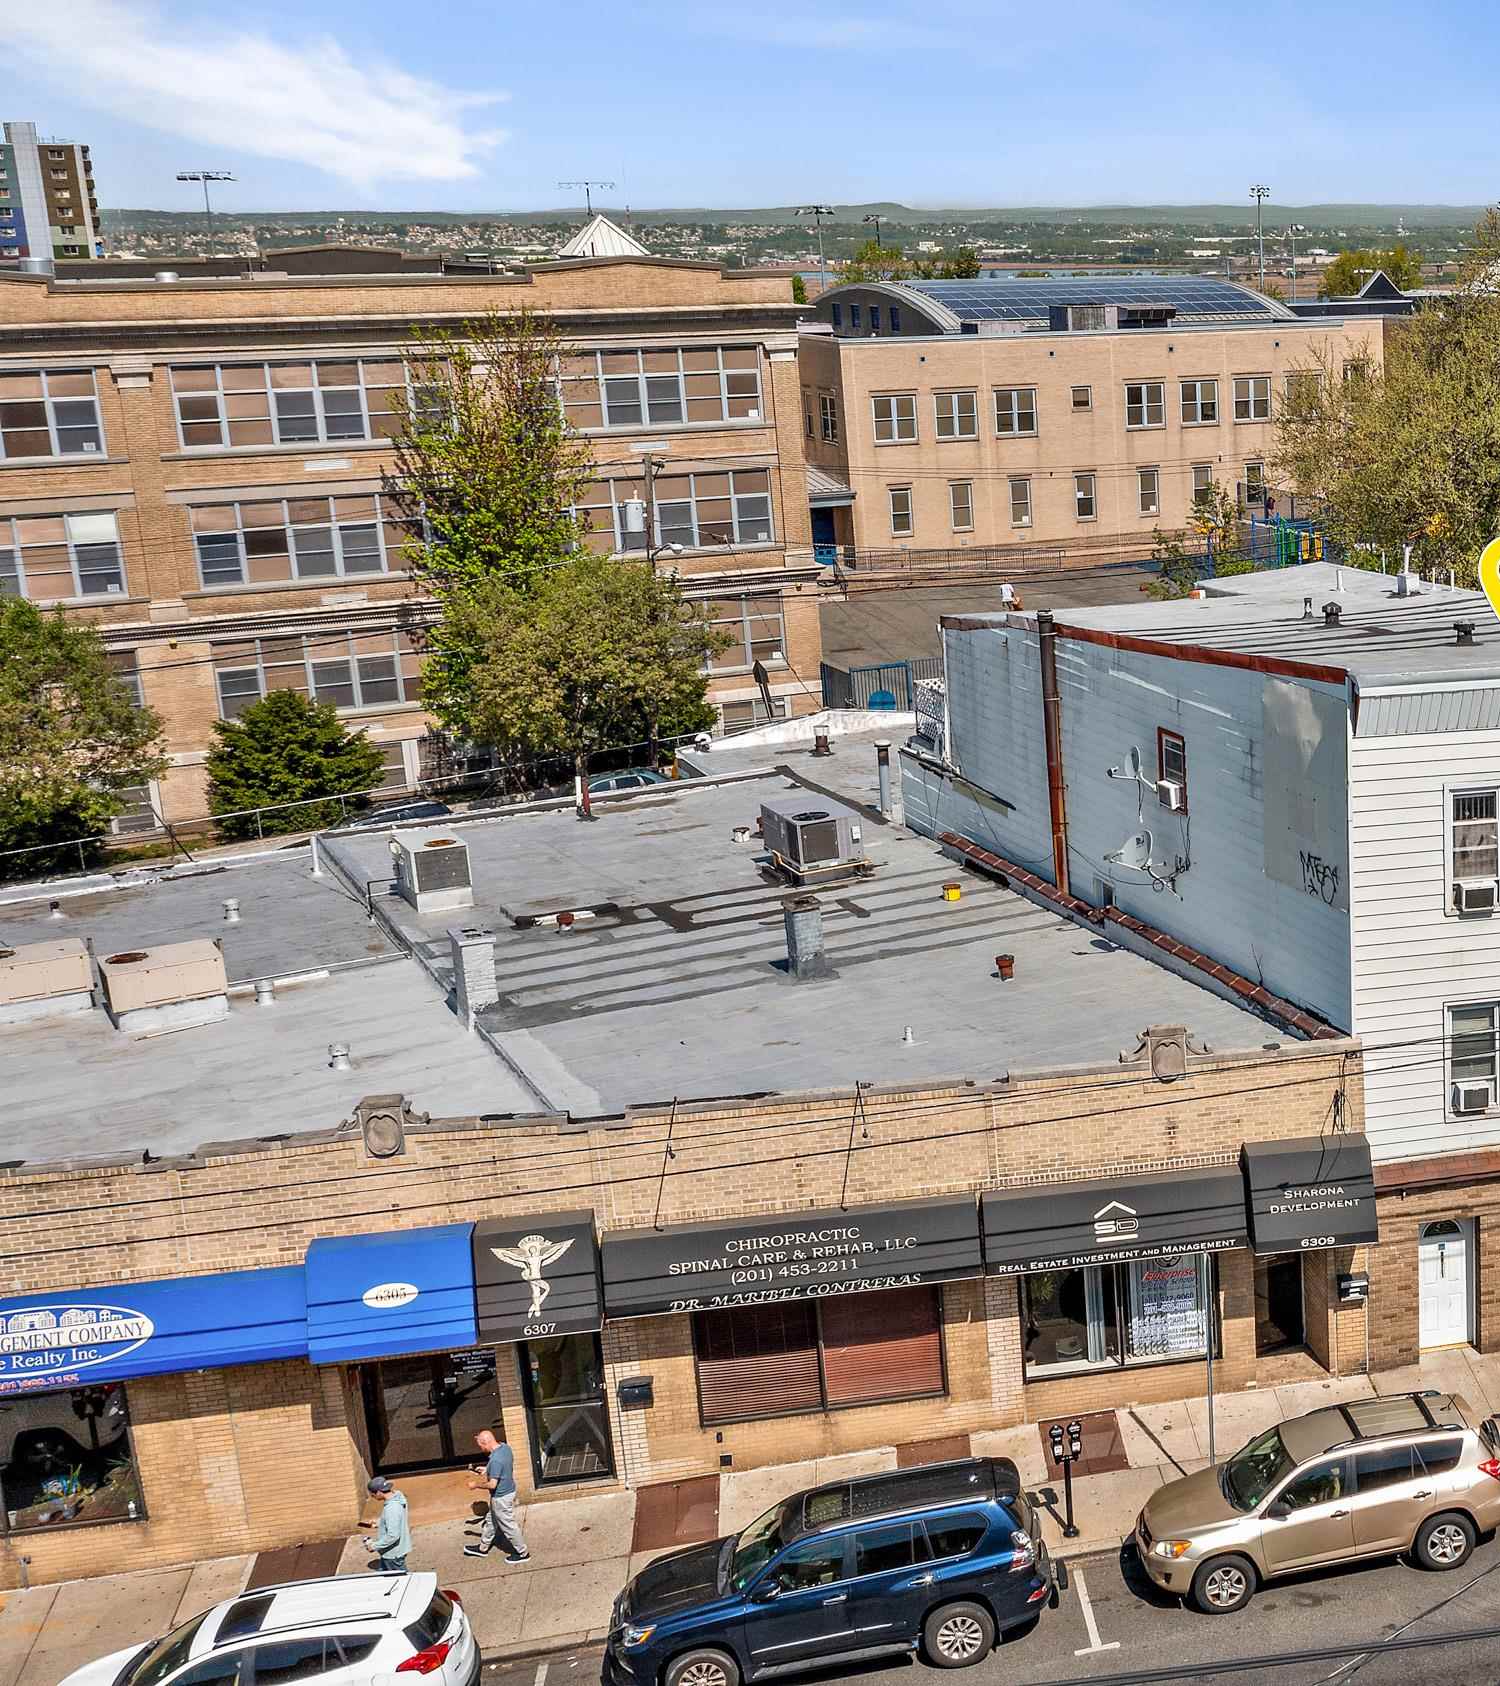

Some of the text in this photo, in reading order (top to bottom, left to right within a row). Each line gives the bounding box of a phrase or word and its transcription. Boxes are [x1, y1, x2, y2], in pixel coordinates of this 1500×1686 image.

[1284, 1186, 1345, 1199] SHARONA
[1270, 1199, 1361, 1214] DEVELOPMENT
[1093, 1216, 1139, 1235] SD
[725, 1227, 861, 1252] CHIROPRACTIC
[1301, 1236, 1336, 1248] 6309
[669, 1236, 918, 1275] SPINAL CARE & REHAB, LLC
[999, 1238, 1237, 1274] REAL ESTATE INVESTMENT AND MANAGEMENT
[731, 1258, 859, 1286] (201) 453-2211
[374, 1287, 408, 1303] 6305
[669, 1273, 922, 1312] DR. MARIBEL CONTRERAS
[68, 1320, 145, 1344] COMPANY
[523, 1322, 557, 1336] 6307
[12, 1351, 66, 1369] Realty
[71, 1348, 102, 1362] Inc.
